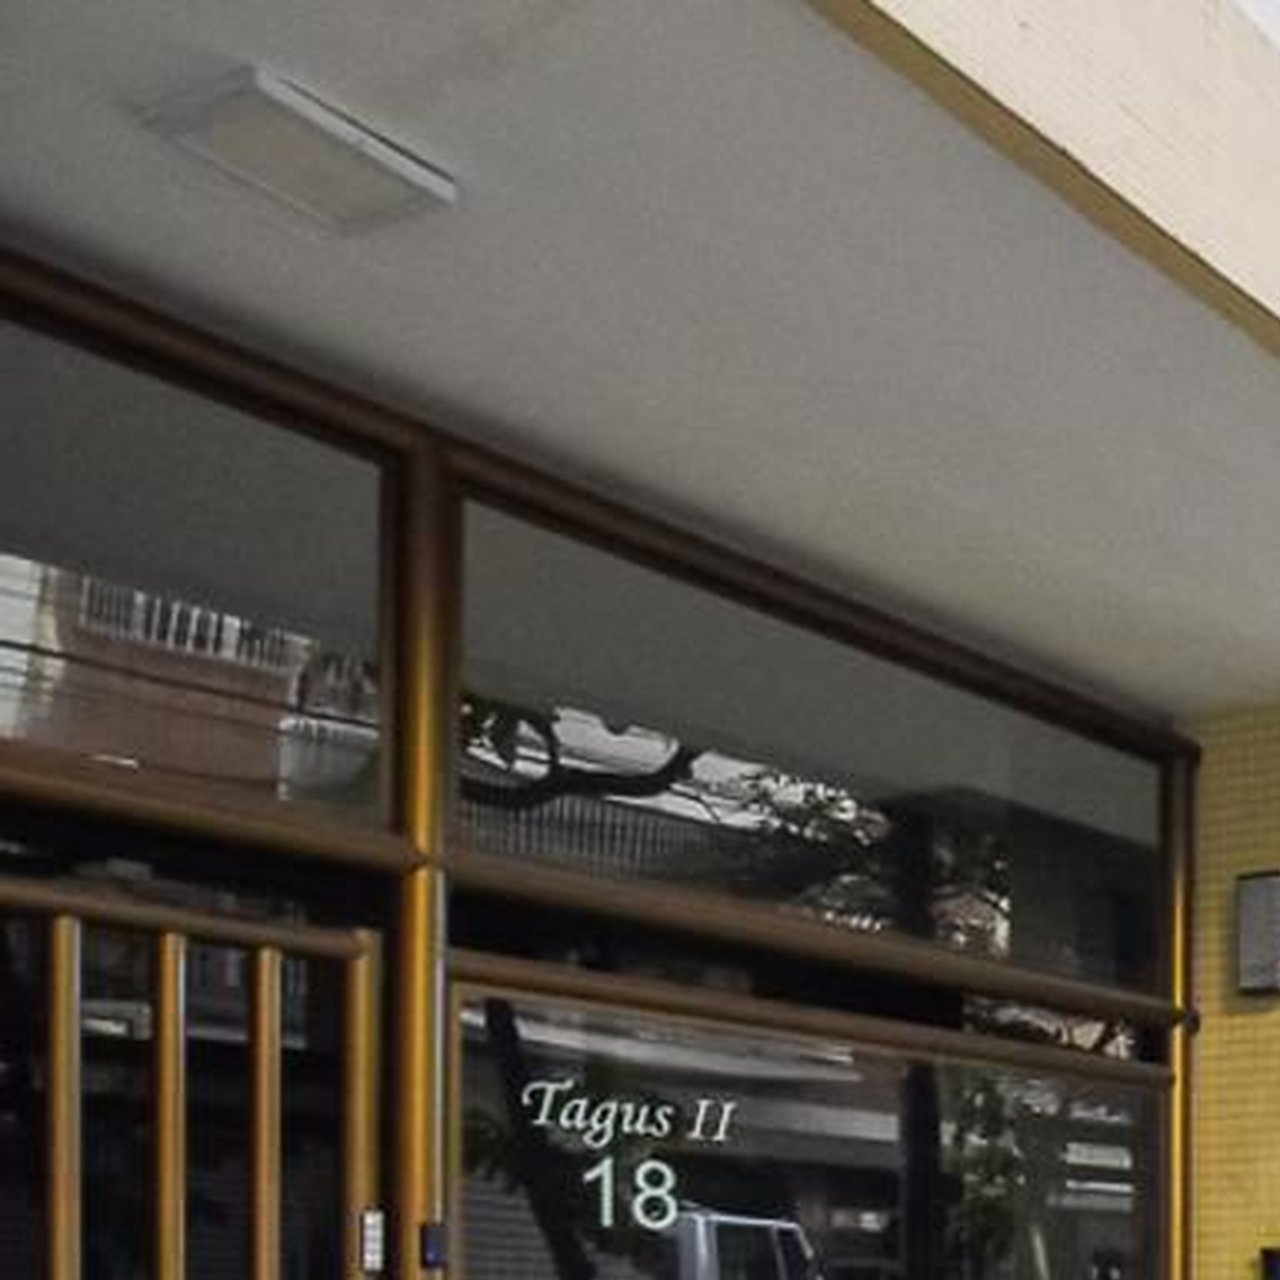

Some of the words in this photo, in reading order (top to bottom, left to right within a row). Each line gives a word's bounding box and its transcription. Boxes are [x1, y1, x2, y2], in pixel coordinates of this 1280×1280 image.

[522, 1079, 674, 1148] Tagus
[686, 1099, 737, 1142] II
[583, 1157, 678, 1230] 18
